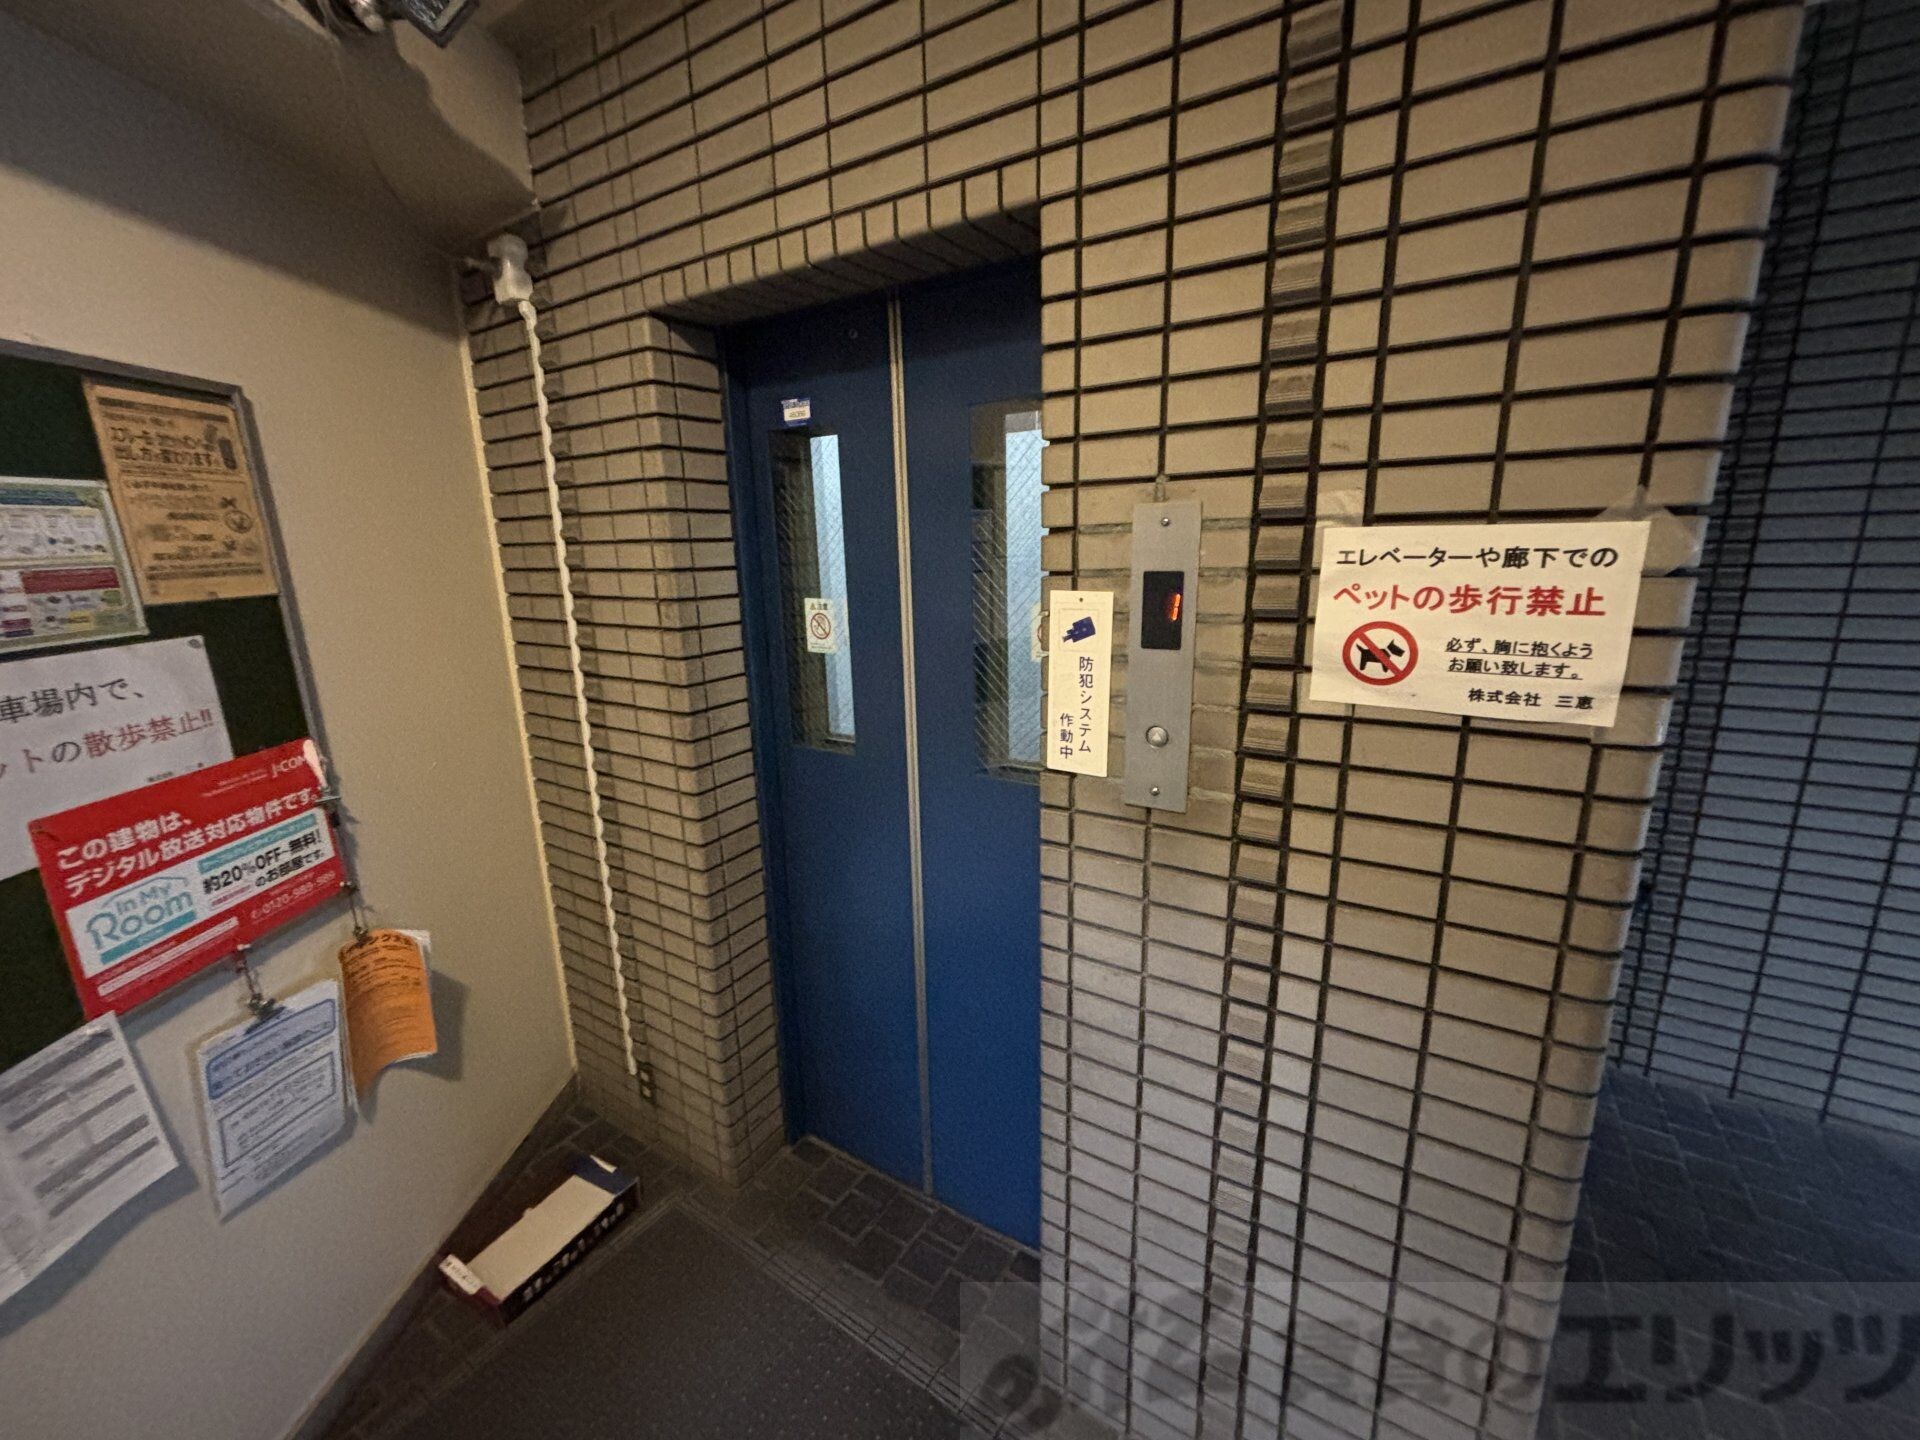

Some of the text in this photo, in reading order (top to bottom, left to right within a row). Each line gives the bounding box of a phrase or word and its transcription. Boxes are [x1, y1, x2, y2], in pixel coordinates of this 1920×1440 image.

[1336, 546, 1618, 569] エレベーターや廊下での
[1171, 593, 1181, 621] 1
[1333, 583, 1606, 617] ペットの歩行禁止
[1445, 637, 1594, 658] 必ず、胸に抱くよう
[1448, 658, 1580, 680] お願い致します。
[1078, 656, 1093, 754] 防犯システム
[1468, 688, 1541, 708] 株式会社
[1060, 712, 1074, 759] 作動中
[57, 811, 192, 870] この建物は、
[65, 787, 318, 898] デジタル放送対応物件です。
[85, 891, 194, 950] Room
[116, 898, 138, 915] In
